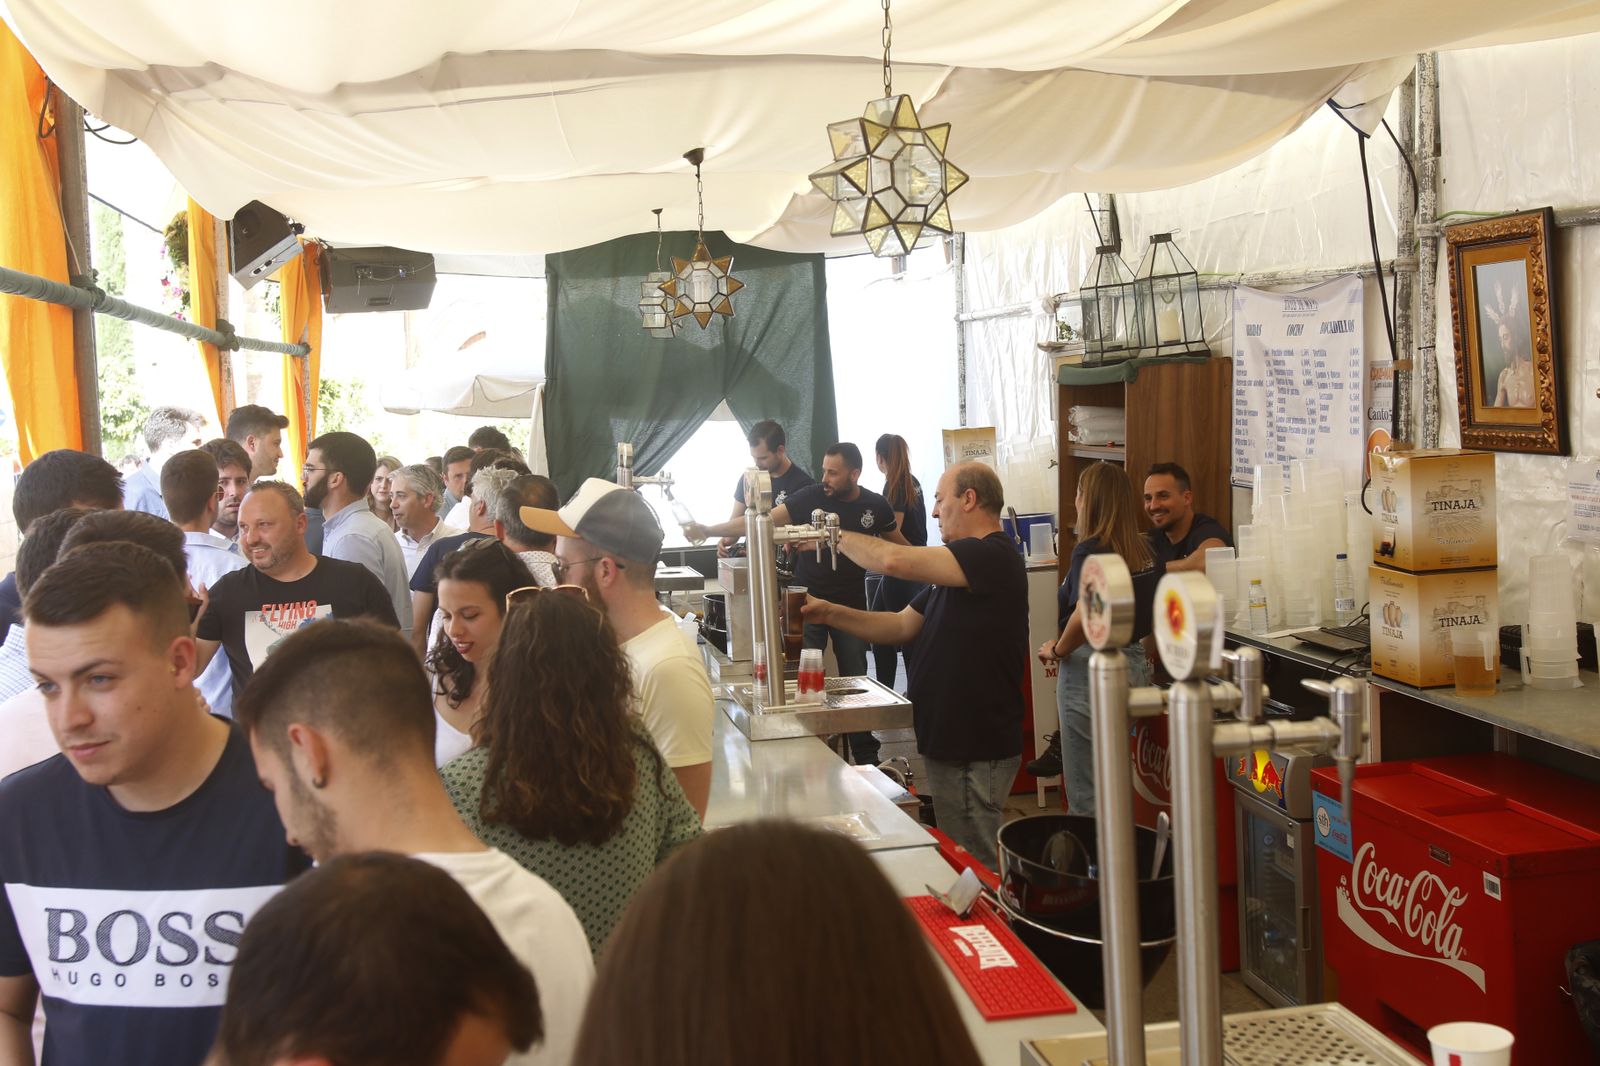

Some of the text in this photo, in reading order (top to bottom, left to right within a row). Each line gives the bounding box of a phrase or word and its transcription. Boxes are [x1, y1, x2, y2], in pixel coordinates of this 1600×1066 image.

[964, 449, 988, 457] TINAJA
[1431, 498, 1477, 512] TINAJA
[259, 599, 318, 623] FLYING
[278, 620, 298, 630] HIGH
[1438, 614, 1482, 628] TINAJA
[1381, 626, 1404, 640] TINAJA
[1351, 841, 1469, 960] Coca-Cola
[44, 907, 245, 967] BOSS
[51, 968, 220, 988] HUGO BOS
